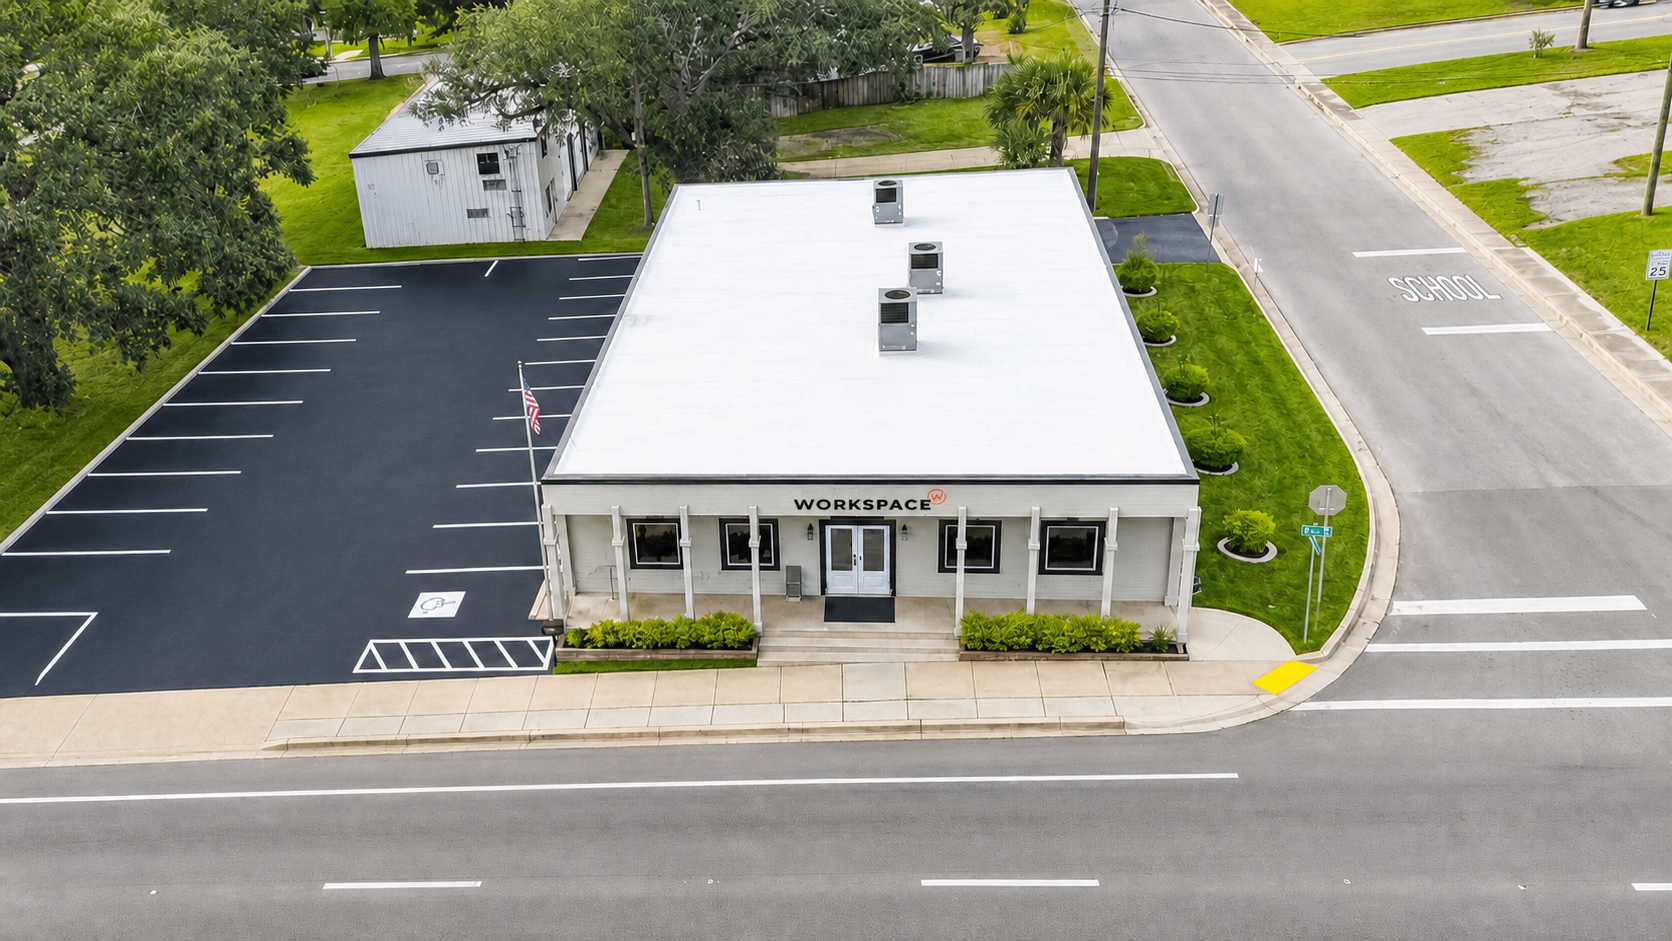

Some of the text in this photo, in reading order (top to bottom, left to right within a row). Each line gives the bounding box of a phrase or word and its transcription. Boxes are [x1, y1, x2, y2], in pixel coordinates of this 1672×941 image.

[1650, 266, 1667, 277] 25
[1387, 274, 1504, 302] SCHOOL
[793, 499, 932, 511] WORKSPACE
